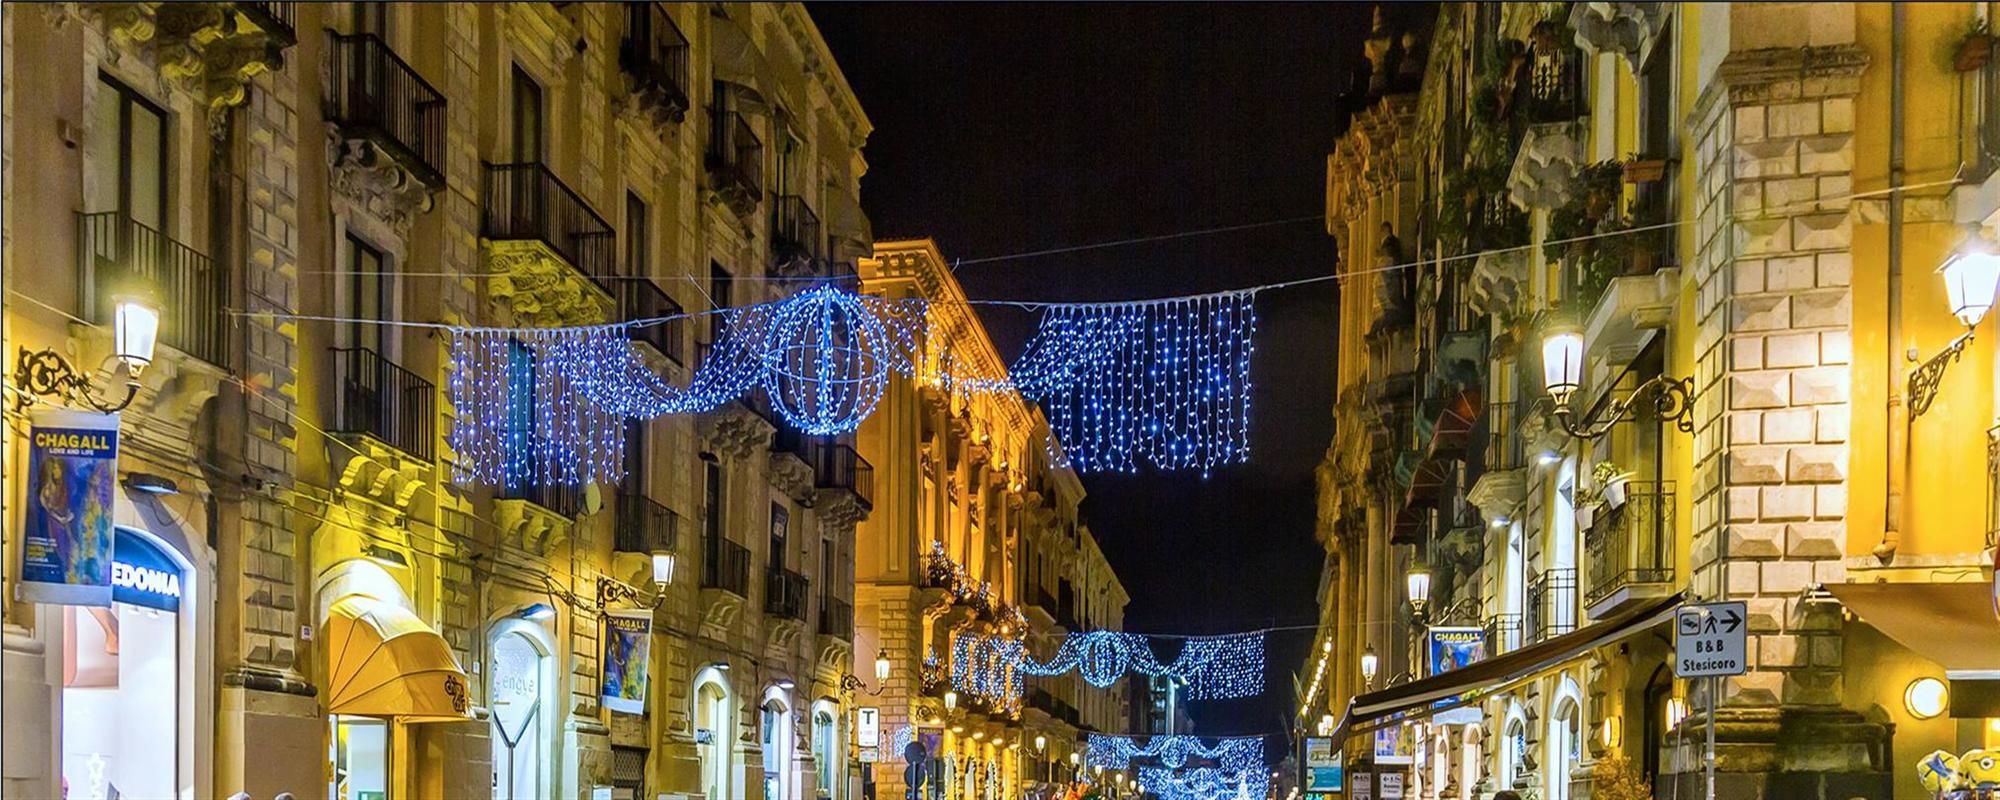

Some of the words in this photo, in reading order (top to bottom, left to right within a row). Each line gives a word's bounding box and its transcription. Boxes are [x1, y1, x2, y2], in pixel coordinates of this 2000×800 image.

[35, 432, 110, 450] CHAGALL
[608, 617, 646, 630] CHAGALL
[1434, 632, 1481, 642] CHAGALL
[1683, 658, 1736, 672] Stesicoro
[862, 710, 875, 725] T
